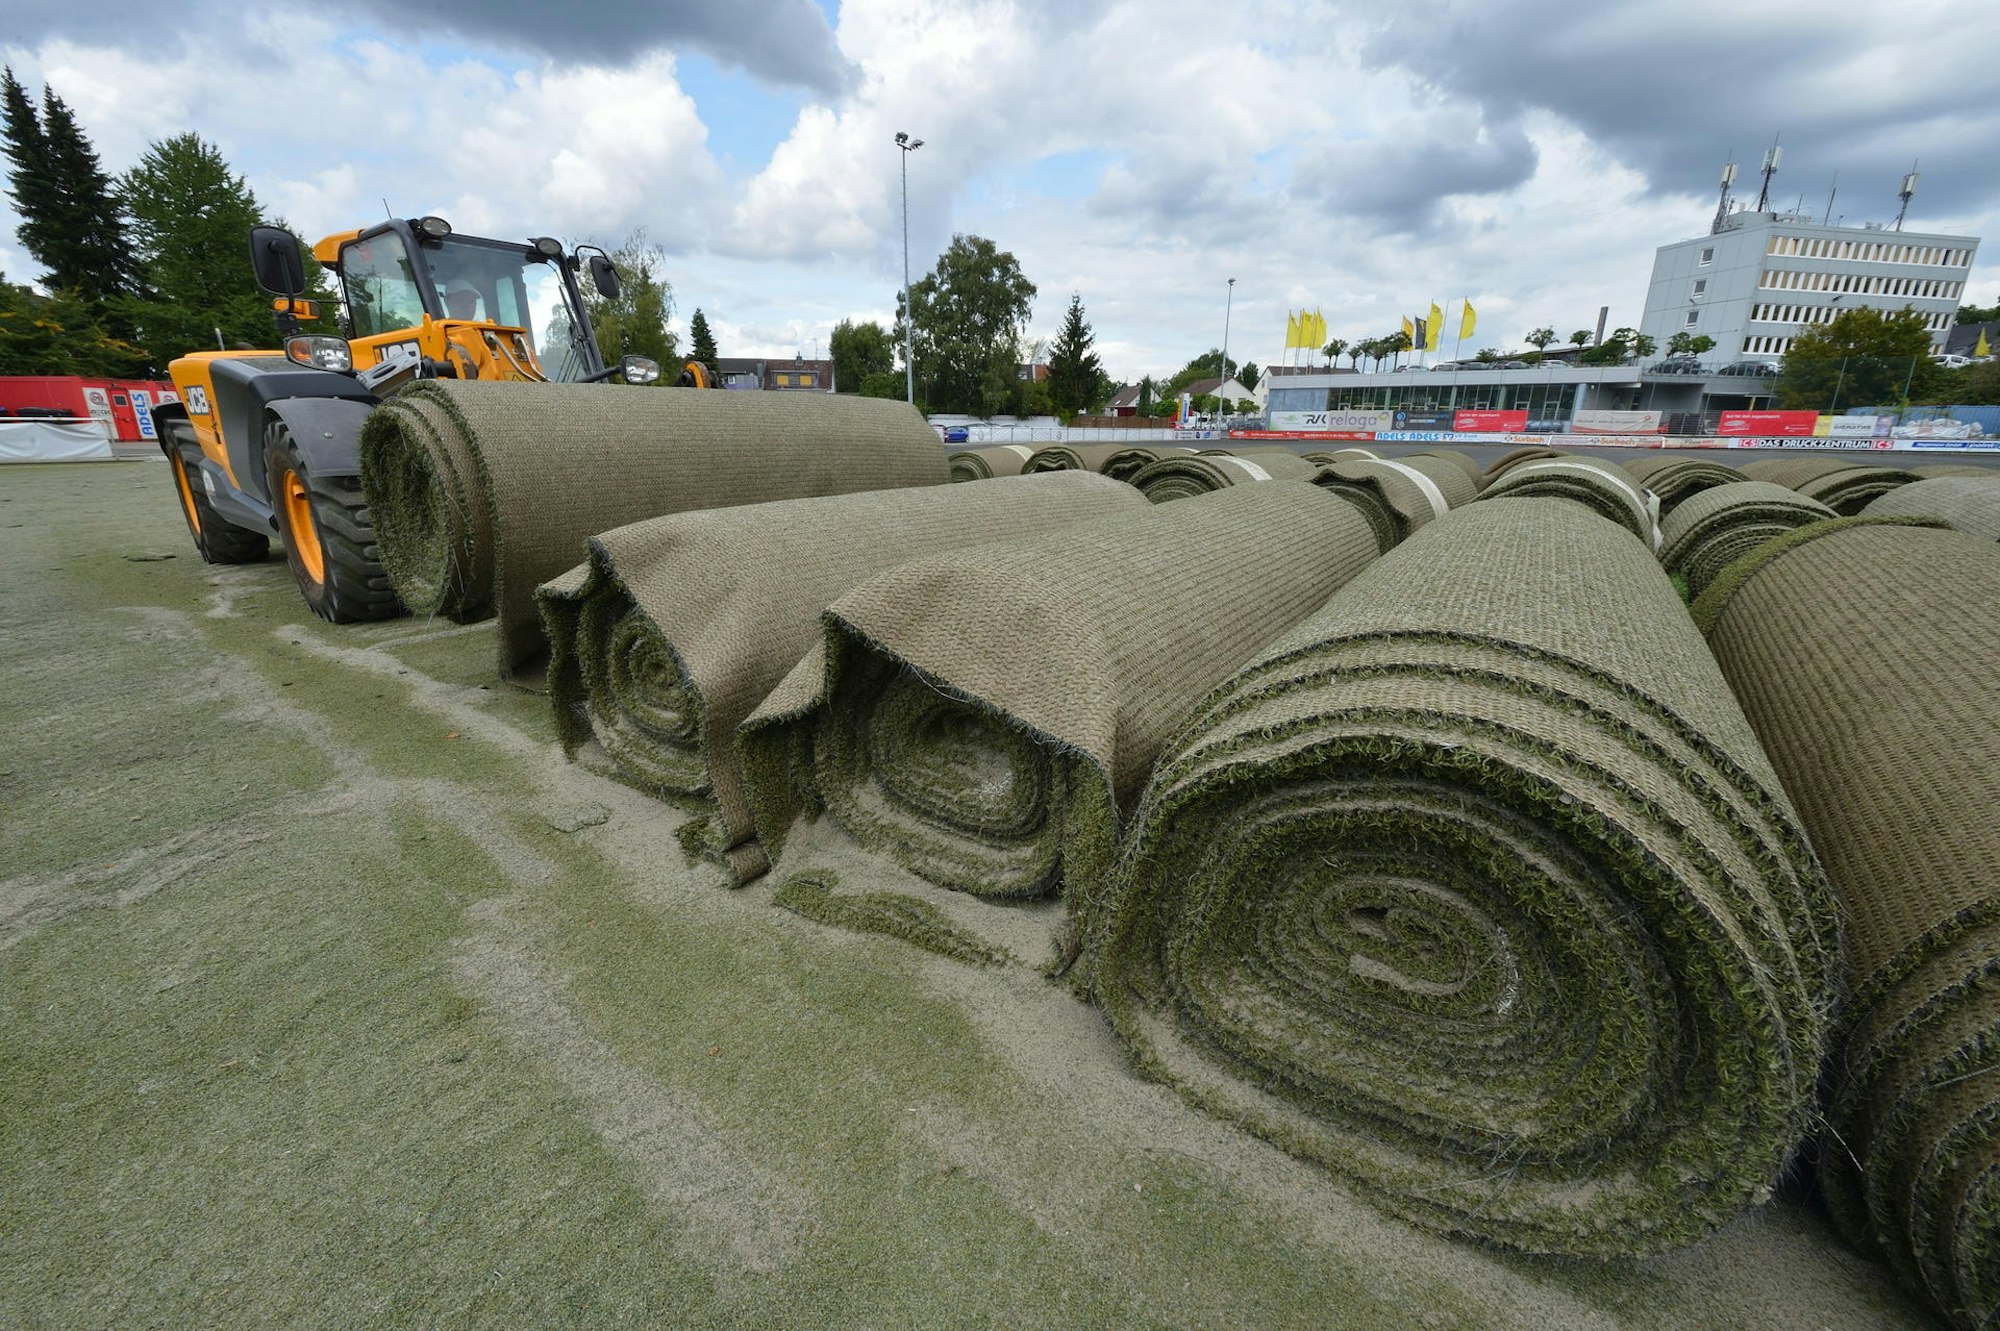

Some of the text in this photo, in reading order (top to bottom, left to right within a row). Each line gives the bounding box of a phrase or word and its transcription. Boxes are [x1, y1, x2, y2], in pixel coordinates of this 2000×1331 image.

[187, 387, 209, 413] JCB
[132, 393, 153, 435] ADELS
[1329, 411, 1377, 429] reloga
[1376, 431, 1441, 441] ADELS ADELS
[1513, 435, 1544, 443] Surbach
[1740, 438, 1893, 449] ICS DAS DRUCKZENTRUM ICS
